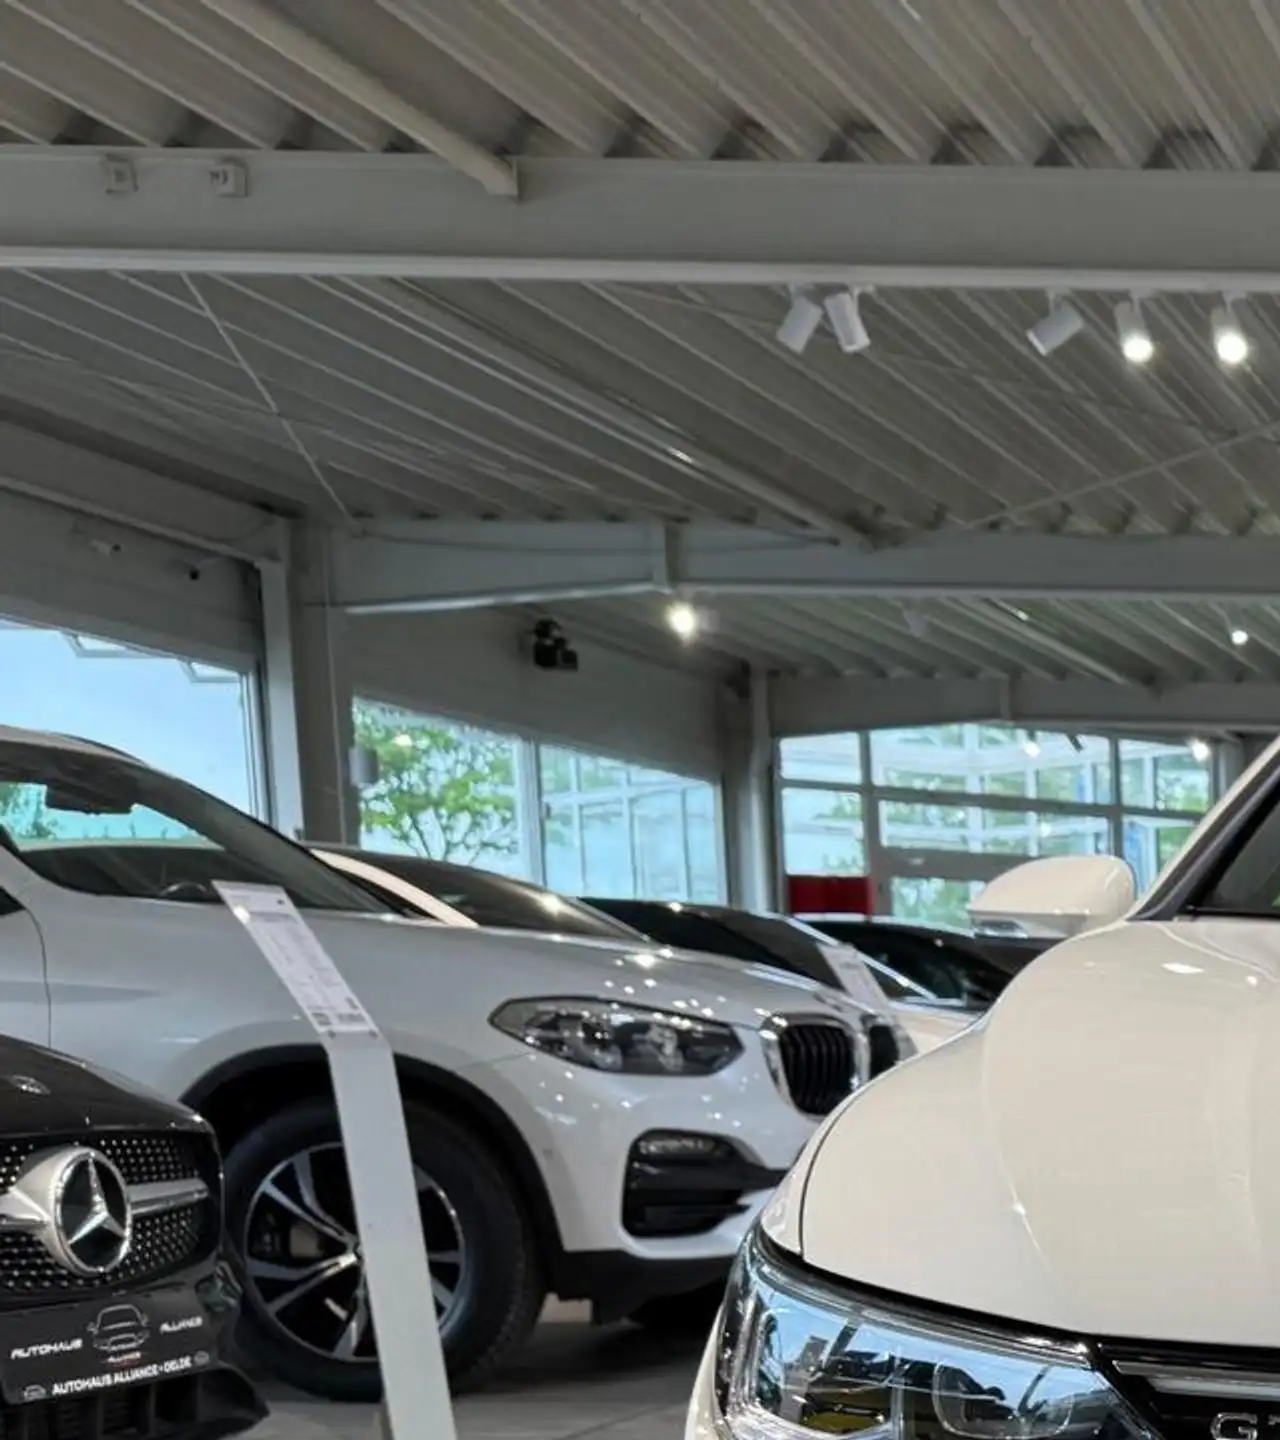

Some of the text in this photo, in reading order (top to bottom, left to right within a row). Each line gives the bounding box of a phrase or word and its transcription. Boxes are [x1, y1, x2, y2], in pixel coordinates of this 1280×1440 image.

[10, 1337, 83, 1360] AUTOHAUS
[51, 1373, 113, 1396] AUTOHAUS
[113, 1363, 158, 1384] ALLIANCE
